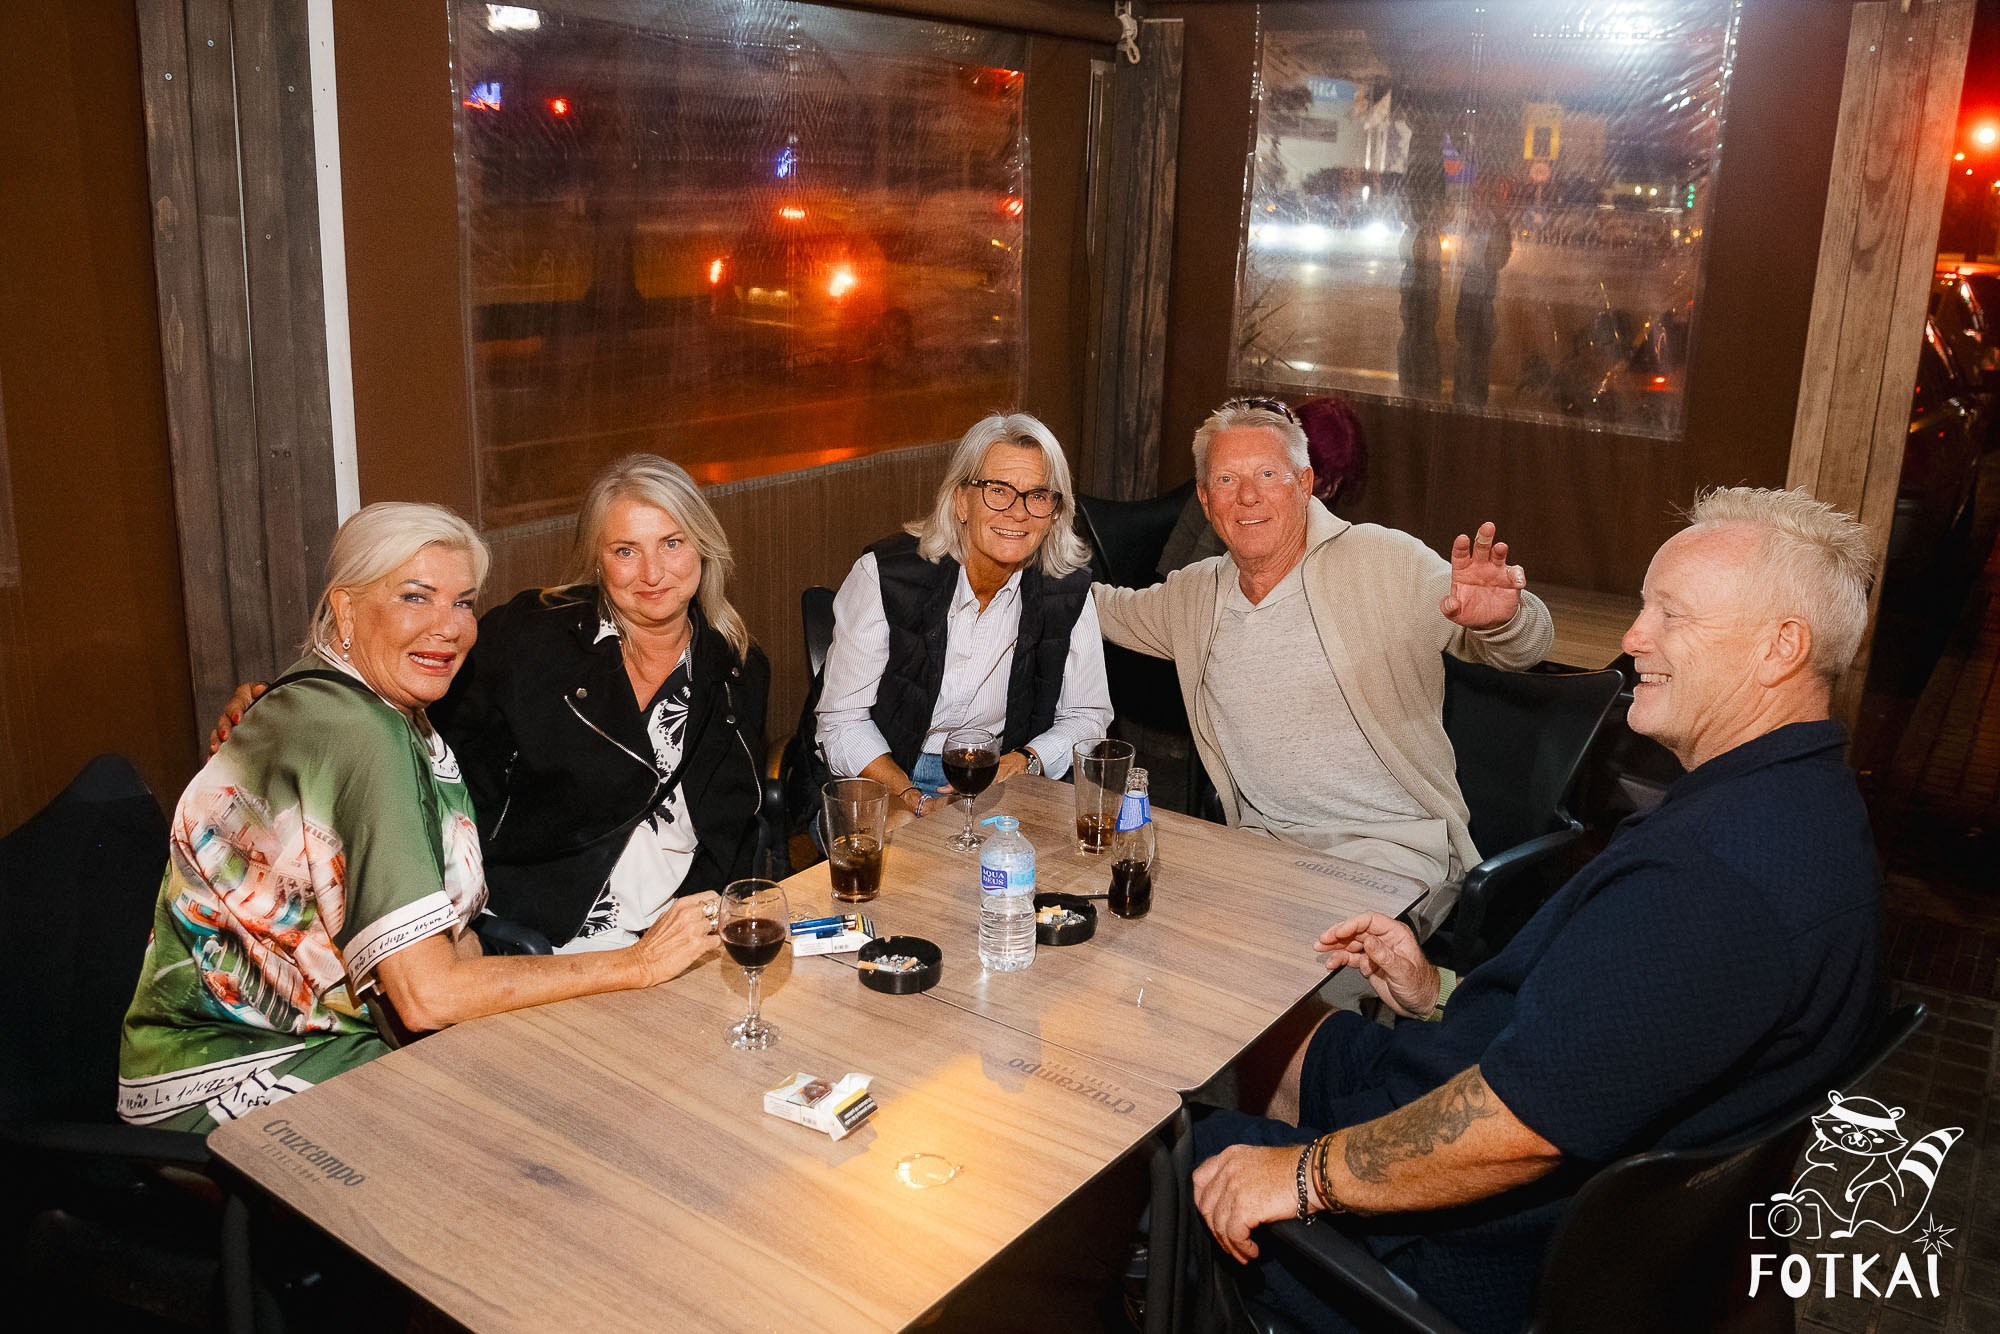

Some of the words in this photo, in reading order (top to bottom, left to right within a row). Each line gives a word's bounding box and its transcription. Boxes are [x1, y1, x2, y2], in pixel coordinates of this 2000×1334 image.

[983, 874, 1004, 885] DEUS
[1295, 860, 1399, 894] Cruzcampo
[1008, 1058, 1136, 1114] Cruzcampo
[262, 1119, 366, 1187] Cruzcampo
